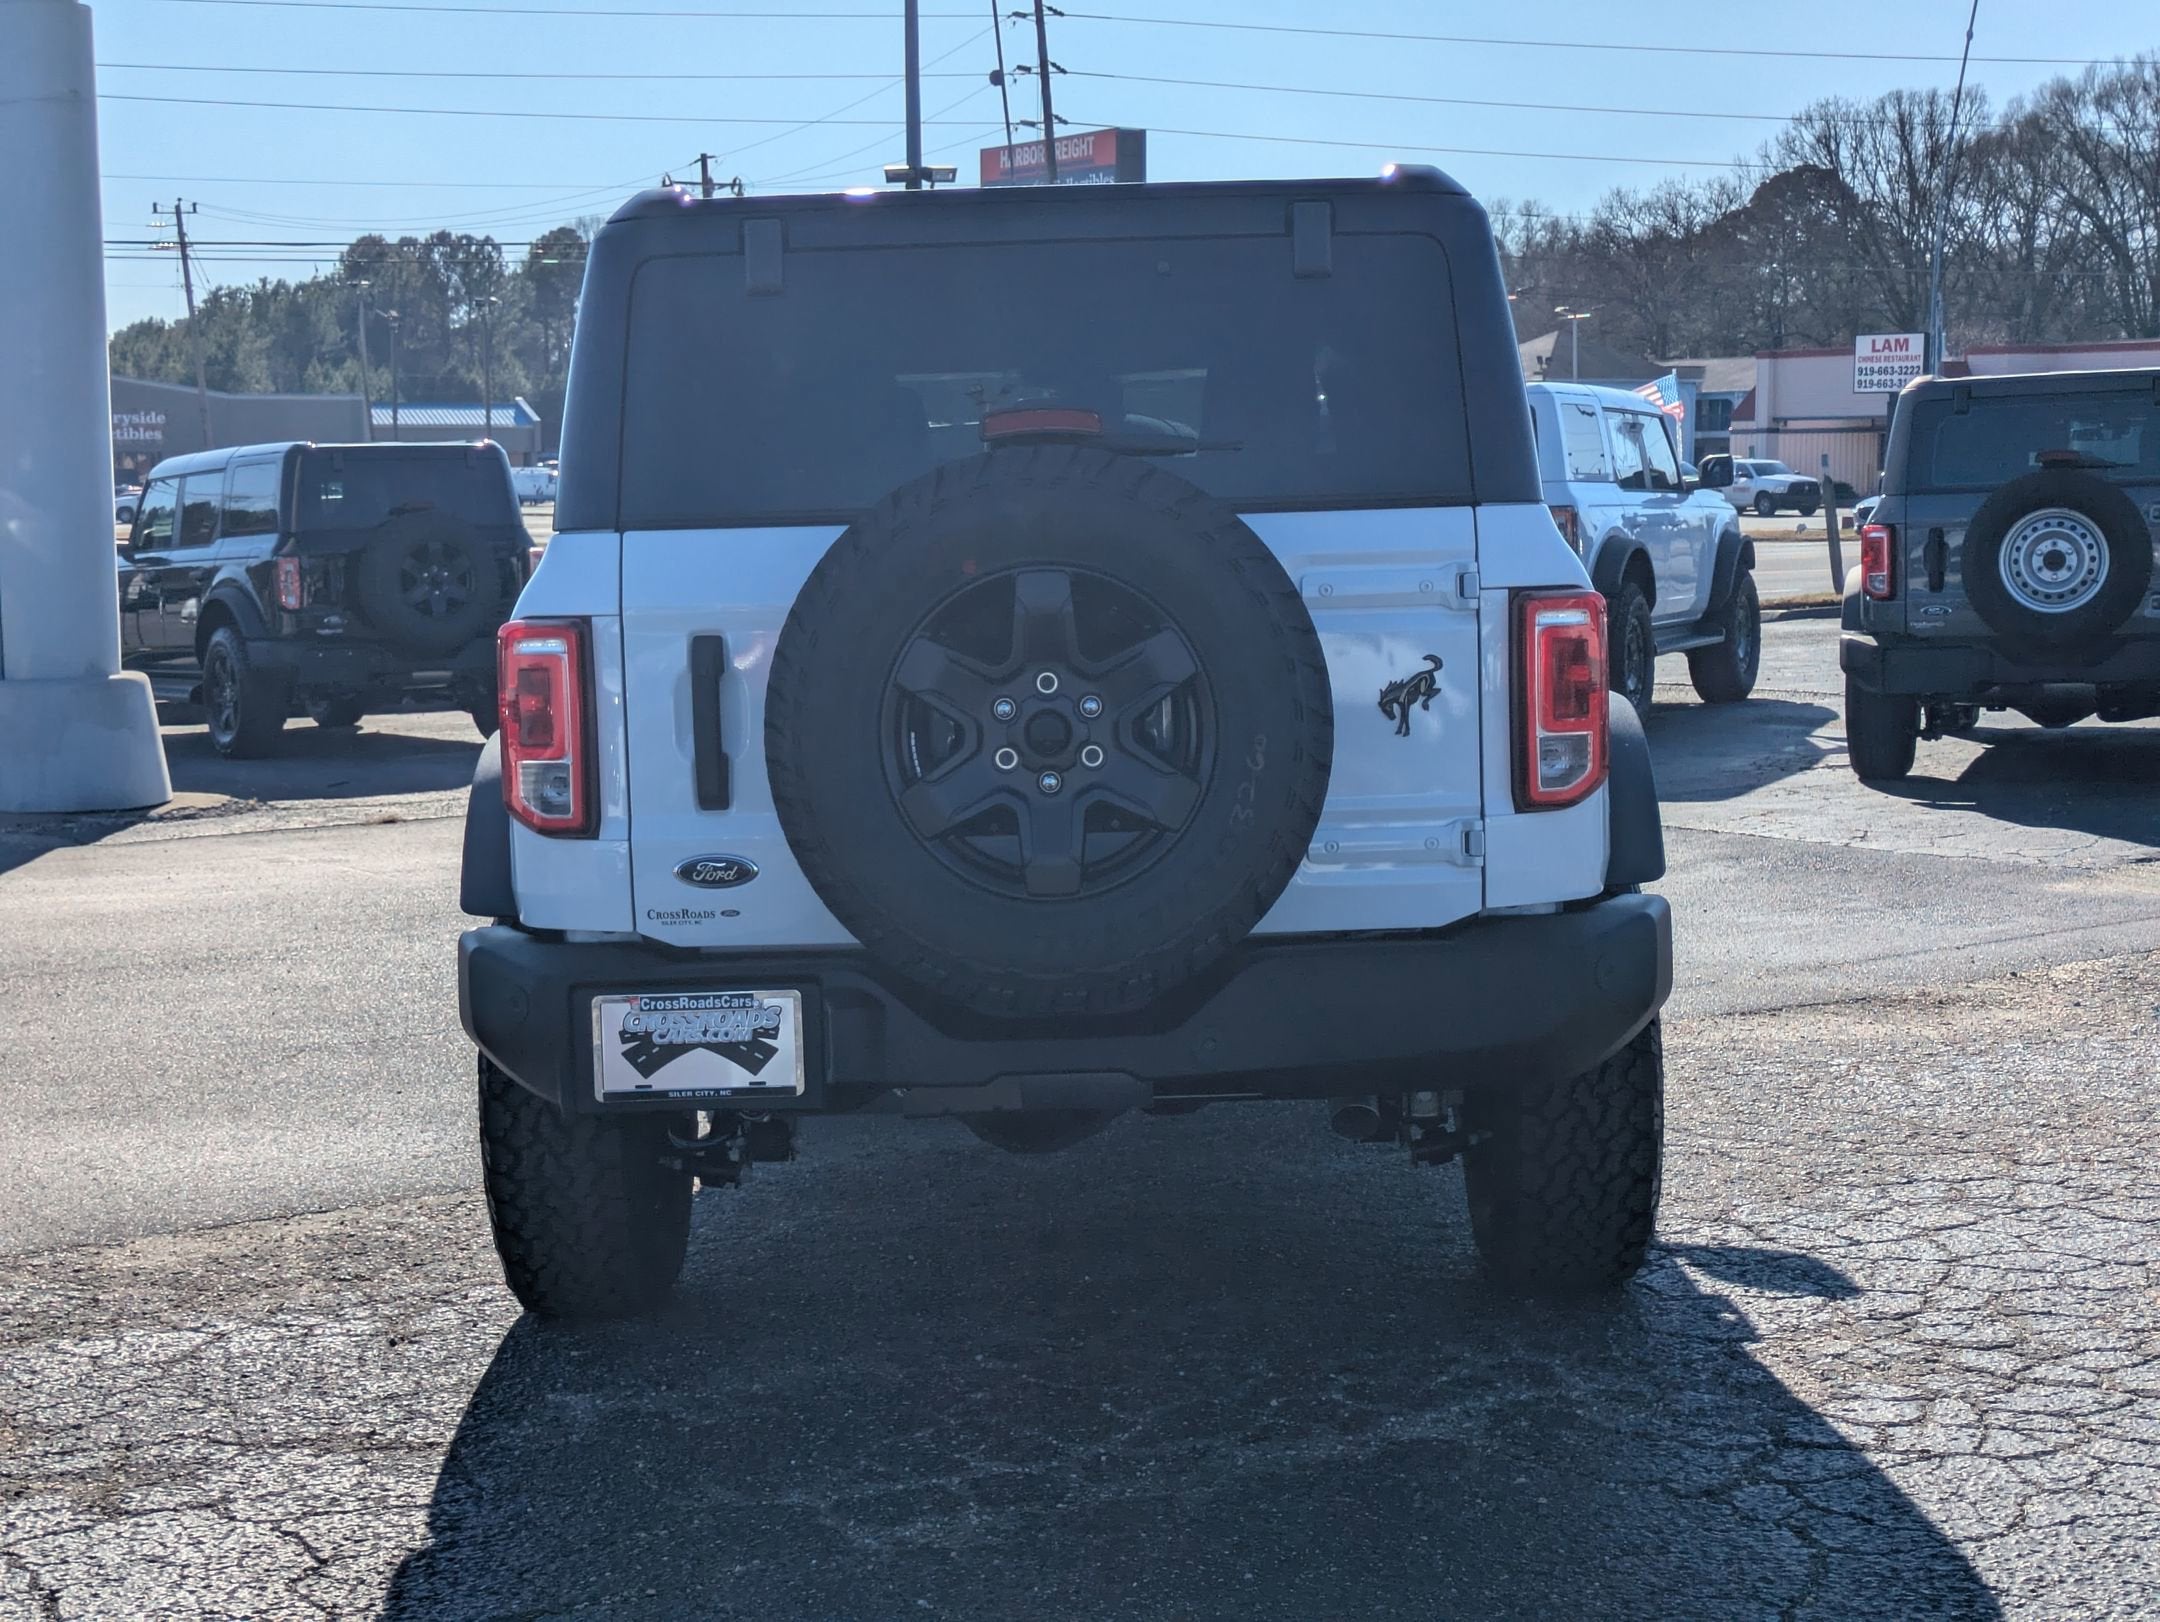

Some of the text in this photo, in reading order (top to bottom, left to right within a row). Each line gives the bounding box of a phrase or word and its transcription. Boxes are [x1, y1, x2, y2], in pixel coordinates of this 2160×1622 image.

[1055, 136, 1095, 160] REIGHT
[1871, 338, 1909, 353] LAM
[1857, 354, 1921, 364] CHINESE RESTAURANT
[1857, 365, 1920, 376] 919-663-3222
[693, 861, 738, 881] Ford
[641, 995, 754, 1011] CrossRoadsCars
[668, 1090, 693, 1098] SILER
